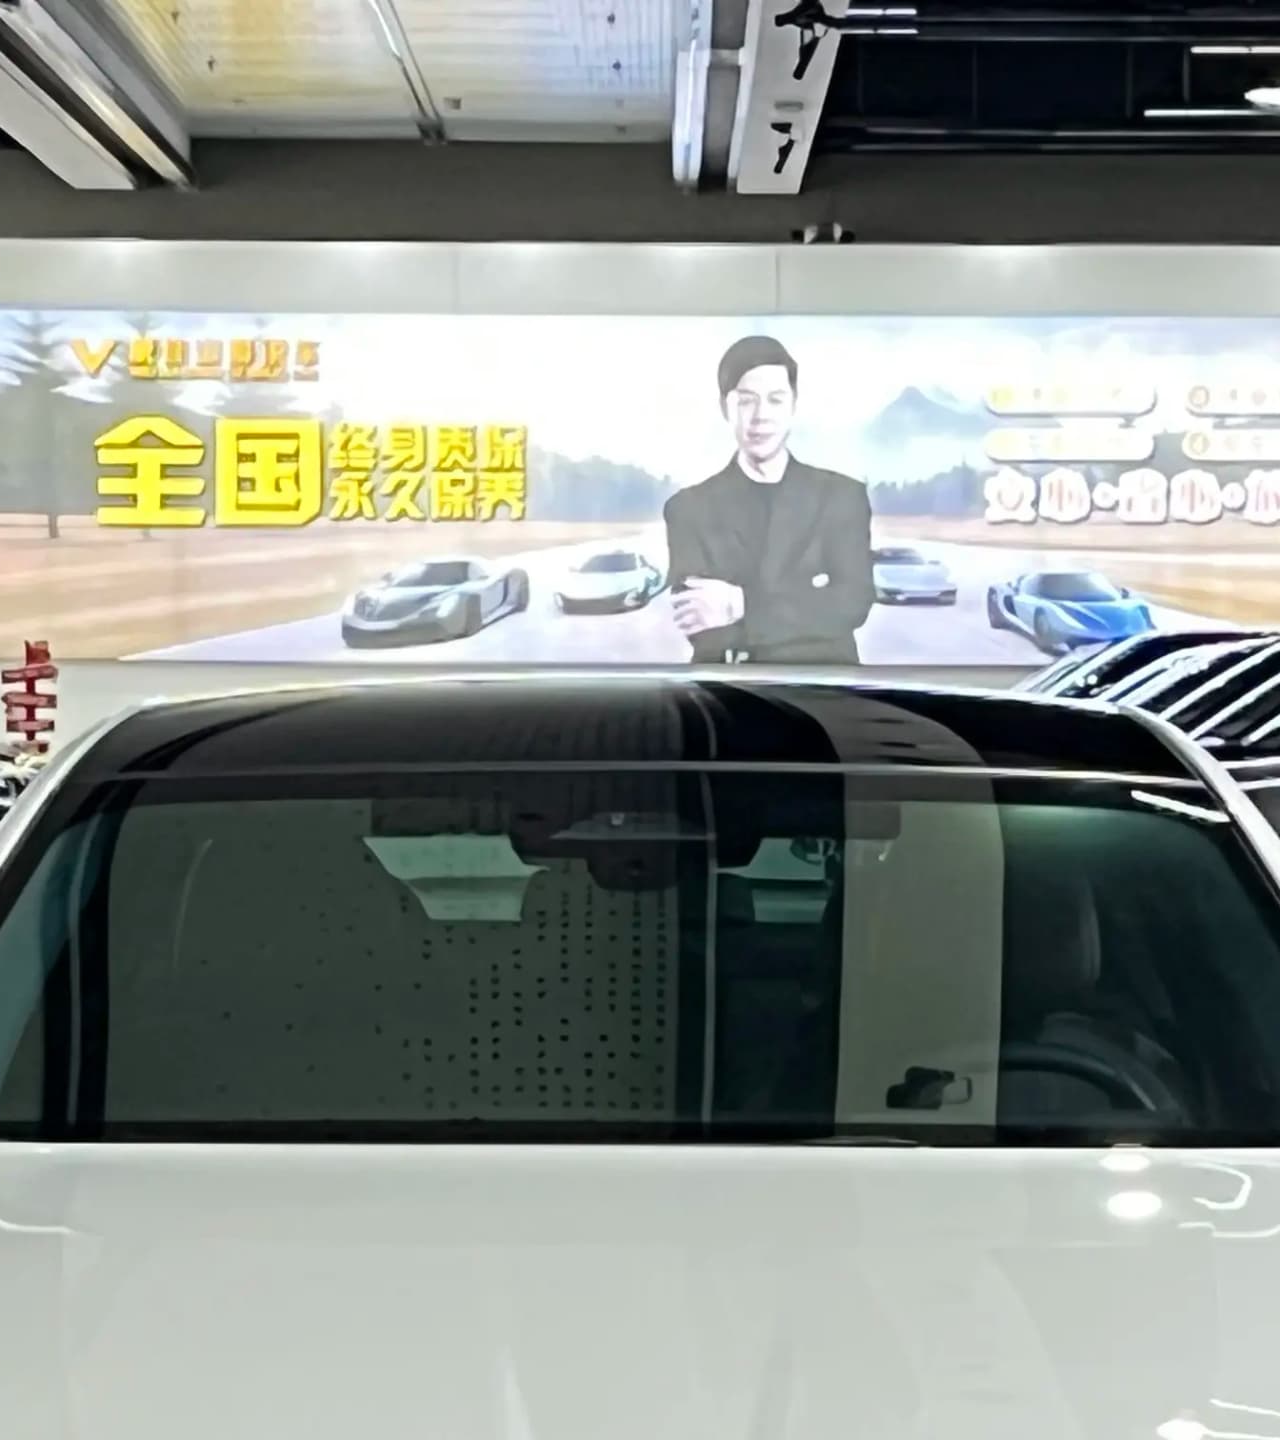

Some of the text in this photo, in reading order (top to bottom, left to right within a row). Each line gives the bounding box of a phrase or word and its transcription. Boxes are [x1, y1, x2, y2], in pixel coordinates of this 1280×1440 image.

[94, 416, 323, 527] 全国
[328, 471, 527, 521] 永久保养
